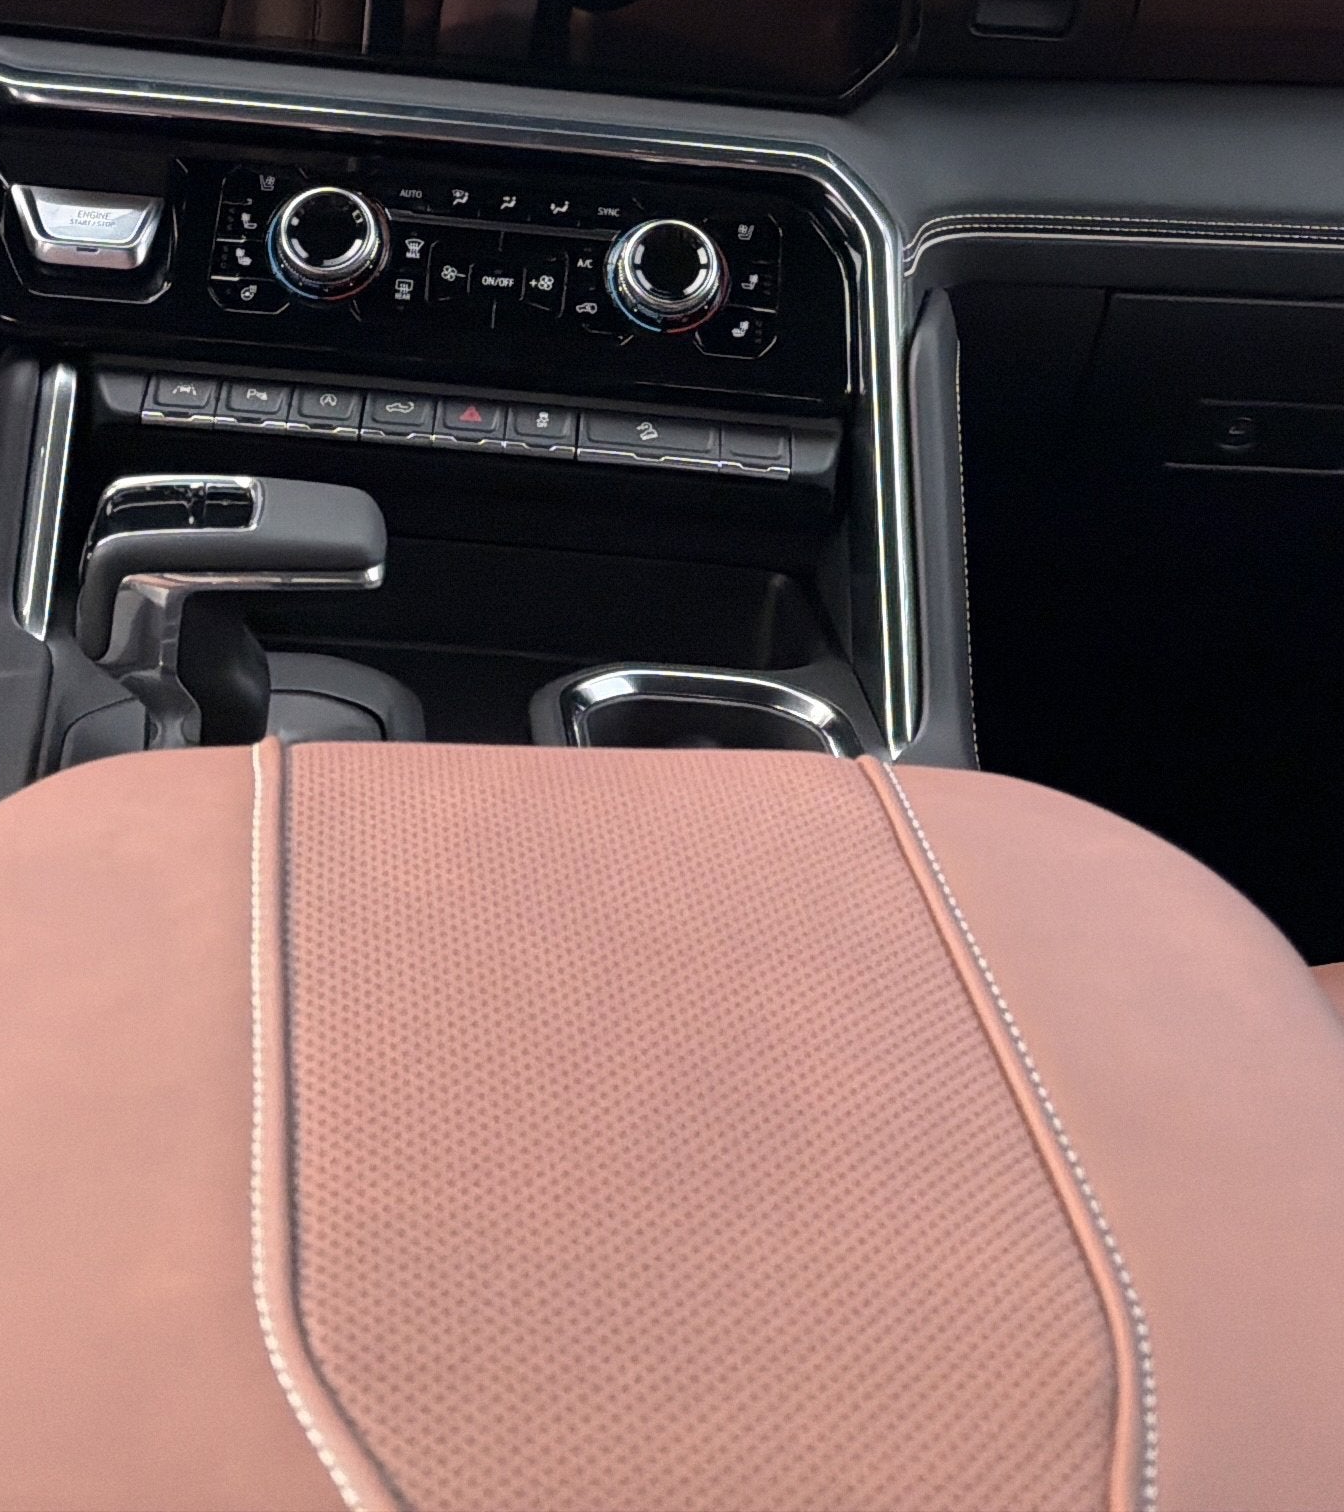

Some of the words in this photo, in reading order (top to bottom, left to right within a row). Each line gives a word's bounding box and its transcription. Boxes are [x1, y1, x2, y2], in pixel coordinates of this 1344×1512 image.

[400, 189, 422, 199] AUTO
[77, 210, 112, 220] ENGINE
[597, 206, 620, 218] SYNC
[577, 258, 594, 269] A/C
[481, 276, 515, 288] ON/OFF
